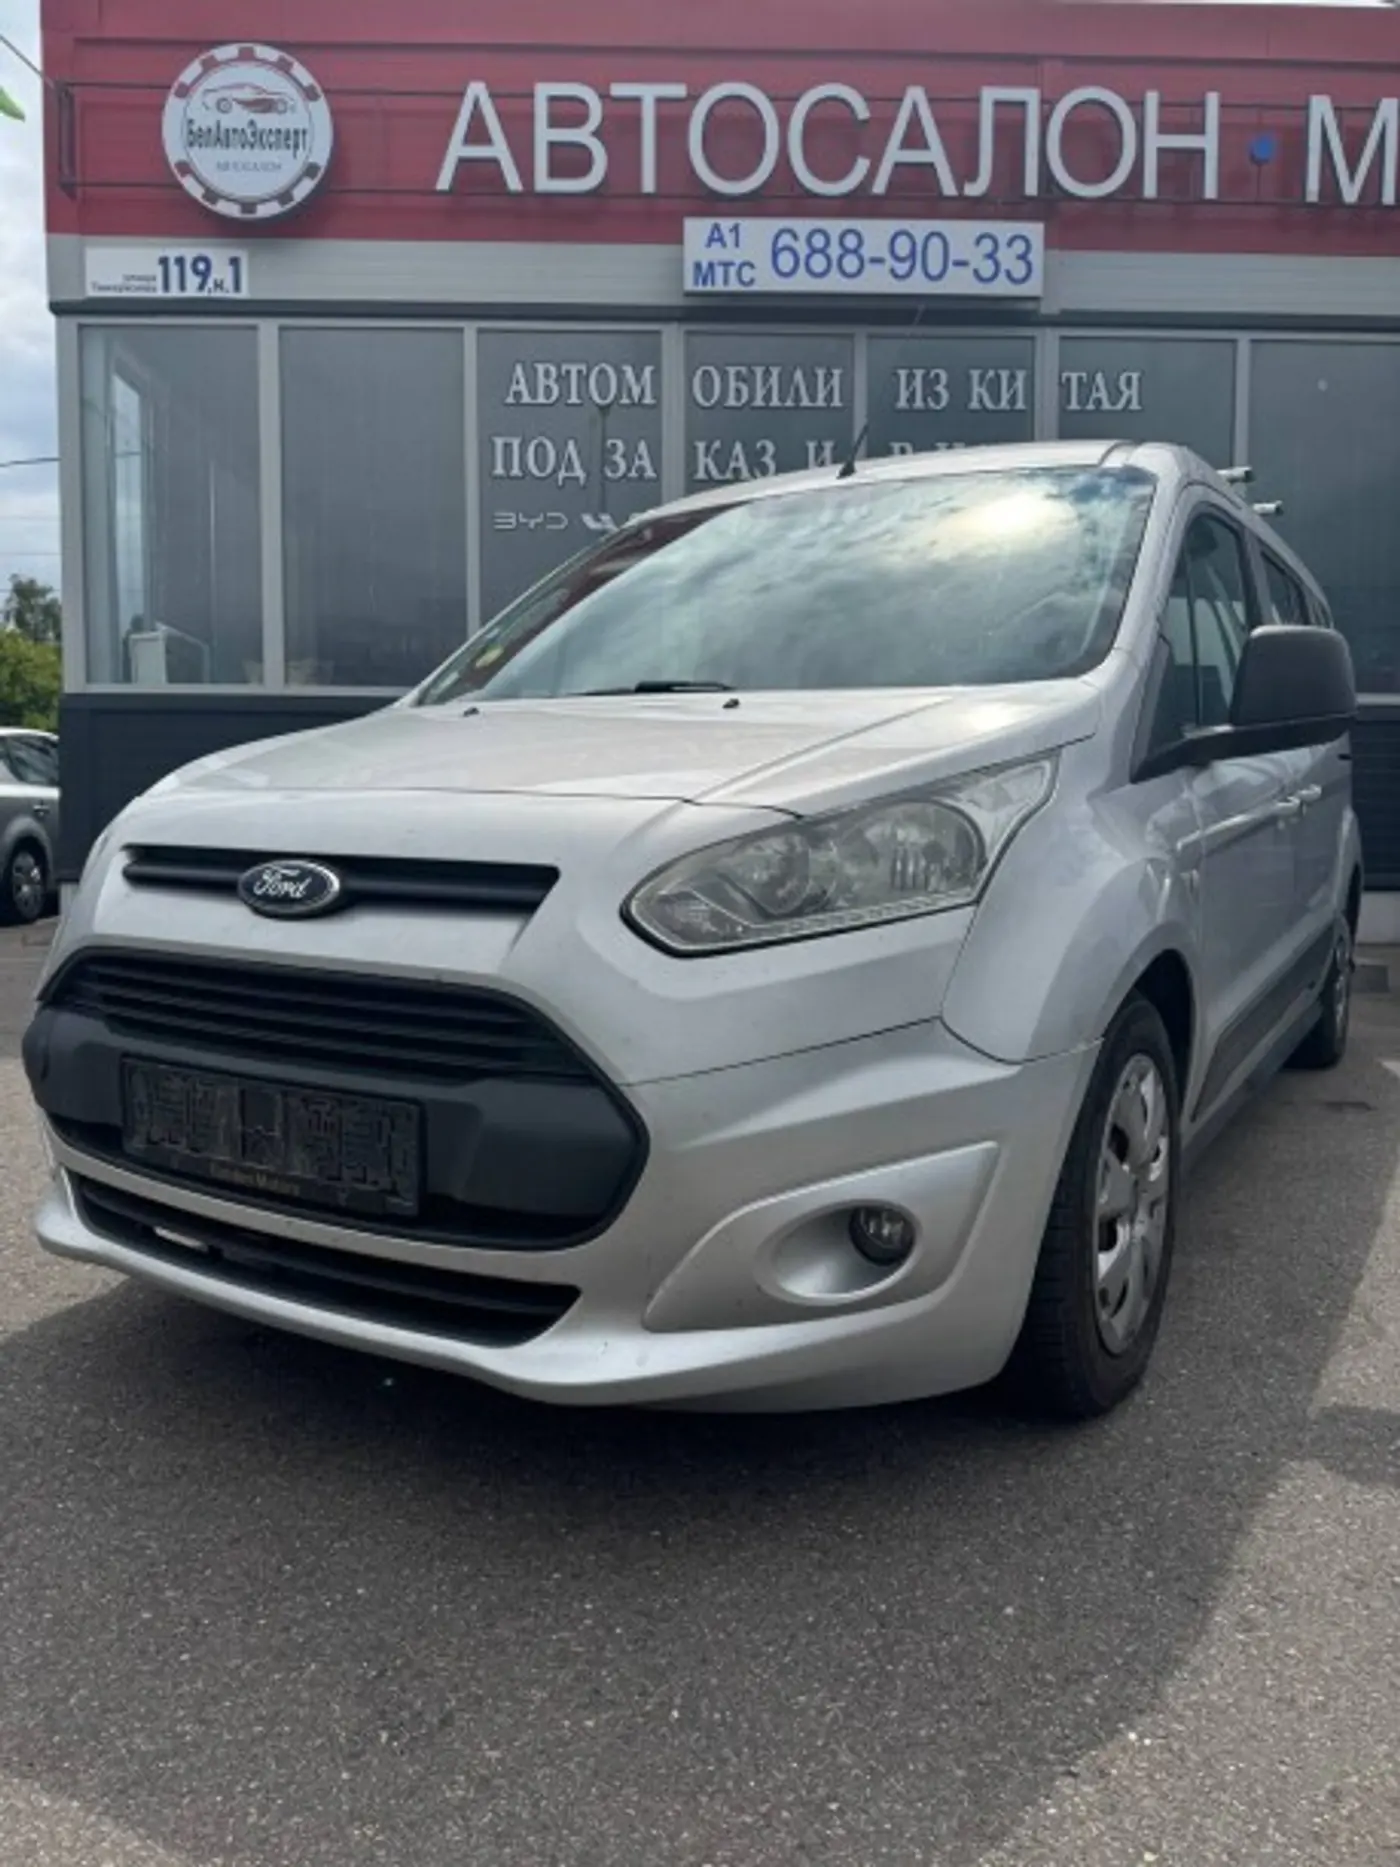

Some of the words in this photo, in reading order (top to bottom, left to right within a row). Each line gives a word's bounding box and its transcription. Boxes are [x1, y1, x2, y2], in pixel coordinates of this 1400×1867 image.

[186, 118, 308, 159] БелАвтоЭксперт
[435, 80, 1220, 200] АВТОСАЛОН
[692, 261, 756, 288] МТС
[770, 227, 1034, 285] 688-90-33
[896, 368, 950, 410] ИЗ
[491, 435, 586, 486] ПОД
[253, 868, 312, 899] Ford
